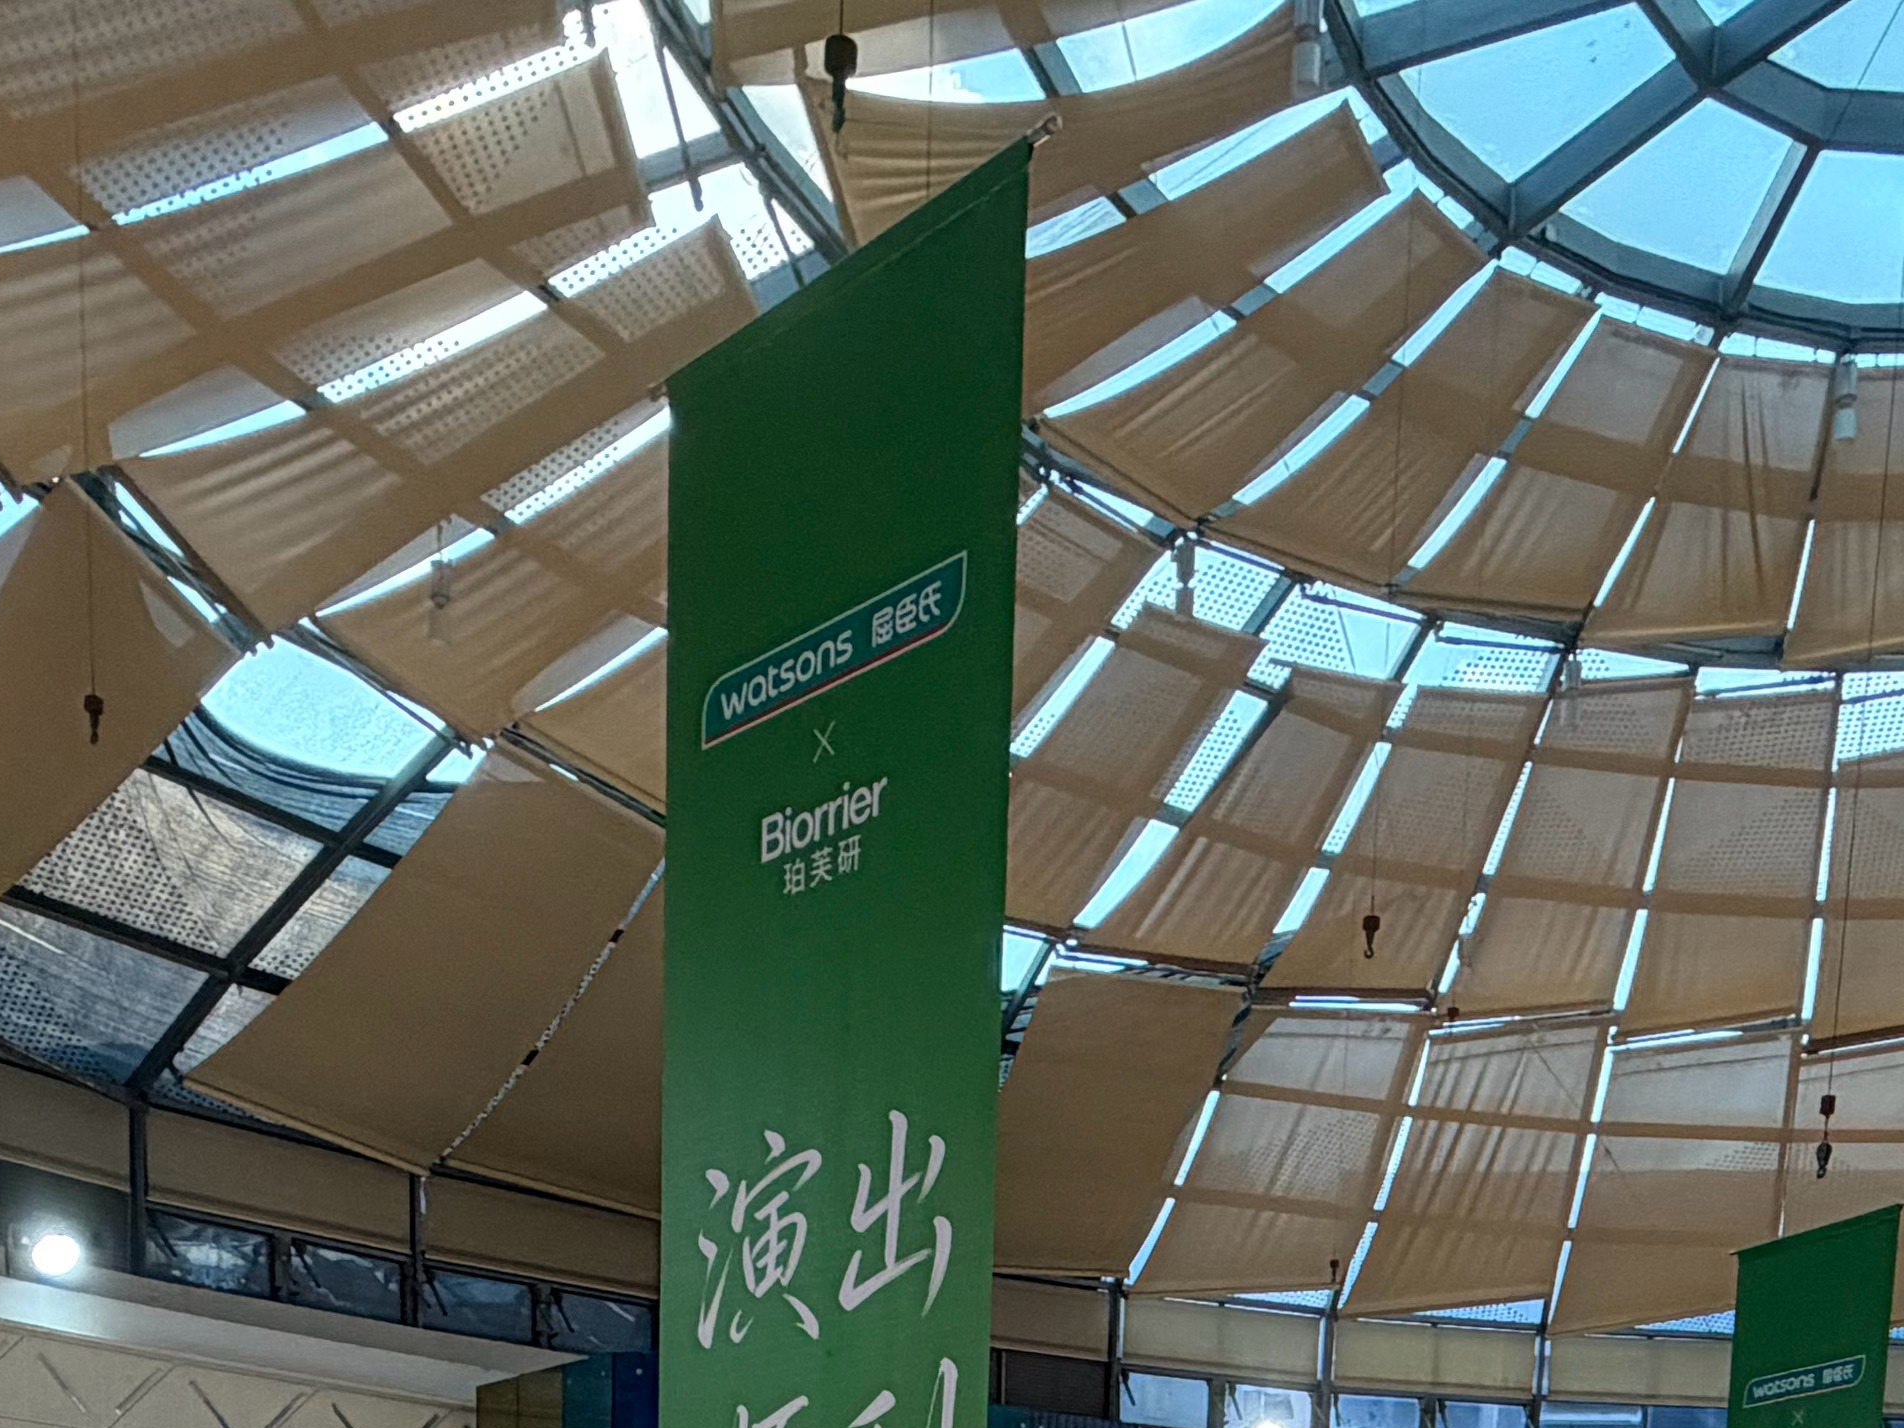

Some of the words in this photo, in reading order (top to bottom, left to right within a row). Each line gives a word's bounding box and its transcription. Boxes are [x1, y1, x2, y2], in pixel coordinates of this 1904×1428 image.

[871, 580, 942, 648] 屈臣氏
[720, 628, 853, 721] watsons
[760, 777, 888, 863] Biorrier
[782, 834, 862, 895] 珀芙研
[696, 1109, 953, 1350] 演出
